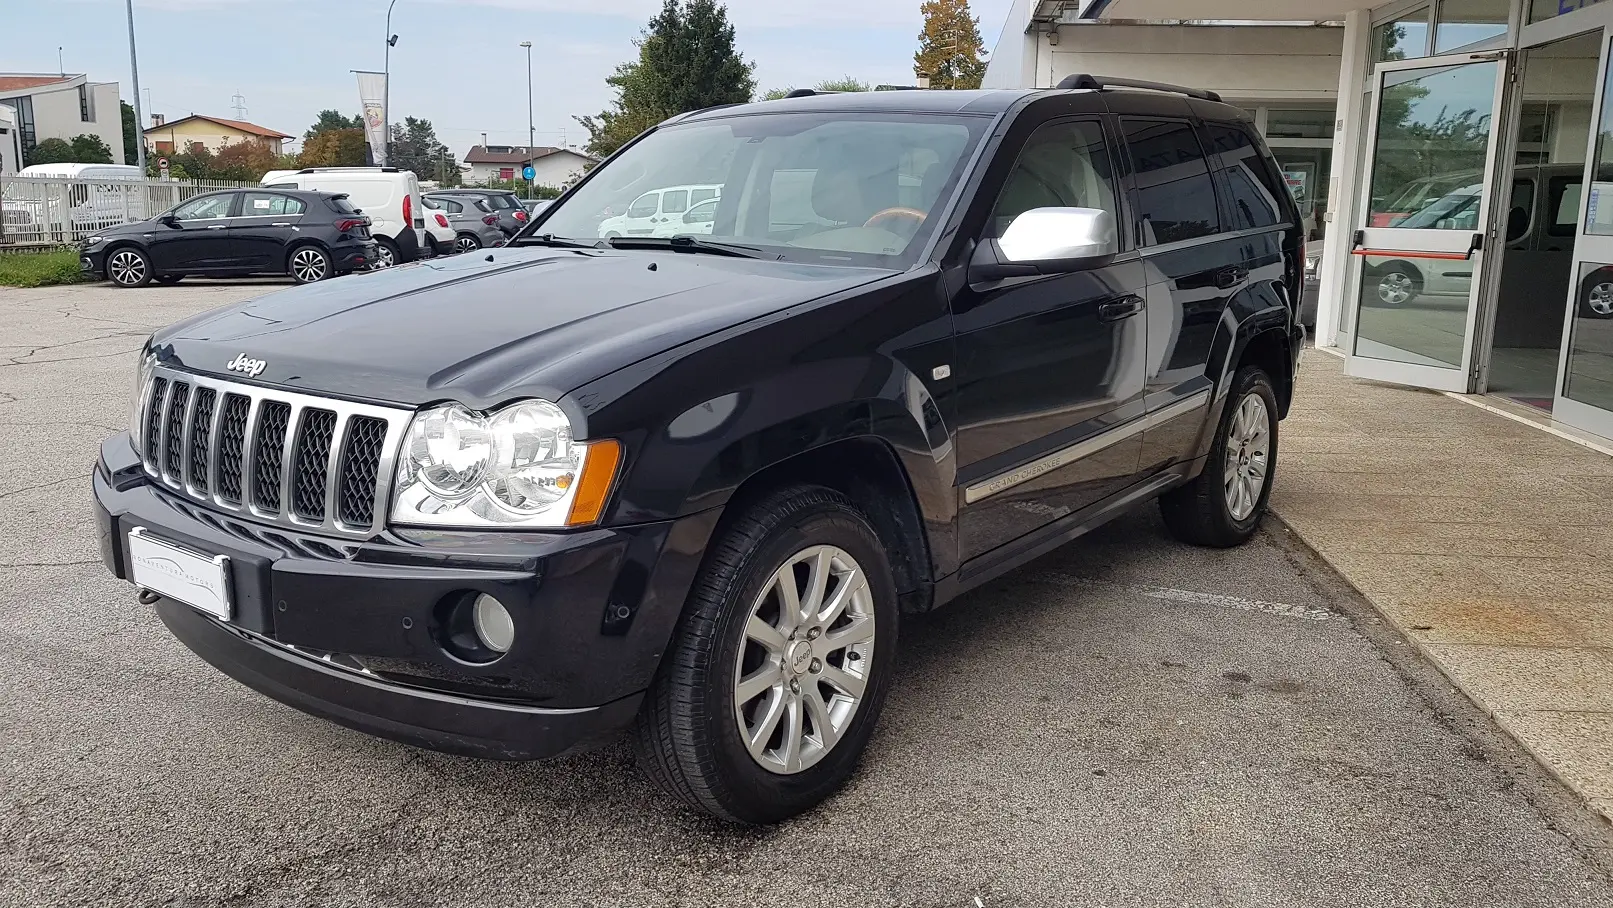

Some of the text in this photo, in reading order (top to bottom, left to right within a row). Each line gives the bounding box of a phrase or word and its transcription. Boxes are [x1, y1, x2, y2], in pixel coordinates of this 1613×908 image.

[226, 352, 267, 378] Jeep
[988, 458, 1060, 491] GRAND CHEROKEE
[185, 573, 215, 589] MOTORS
[794, 649, 810, 666] Jeep
